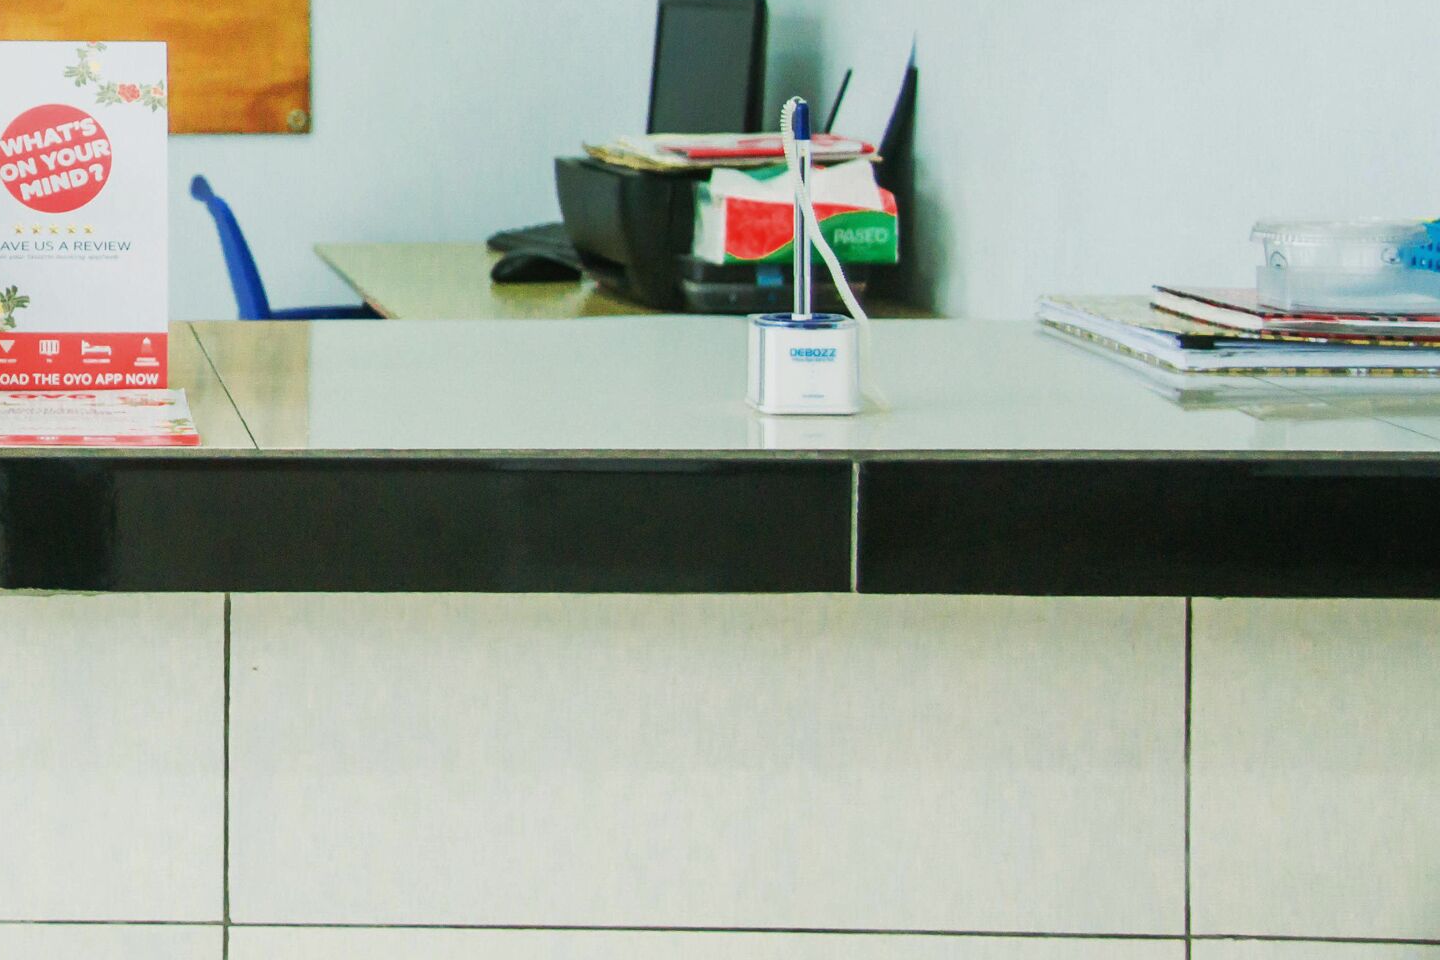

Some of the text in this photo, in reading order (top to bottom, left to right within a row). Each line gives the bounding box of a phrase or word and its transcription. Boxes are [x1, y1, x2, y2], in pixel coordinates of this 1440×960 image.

[0, 139, 110, 182] ON YOUR
[19, 164, 103, 201] MIND?
[34, 240, 54, 251] US
[58, 240, 69, 251] A
[73, 240, 131, 251] REVIEW
[33, 373, 60, 385] THE
[63, 373, 92, 385] OYO
[95, 373, 123, 385] APP
[125, 373, 159, 385] NOW
